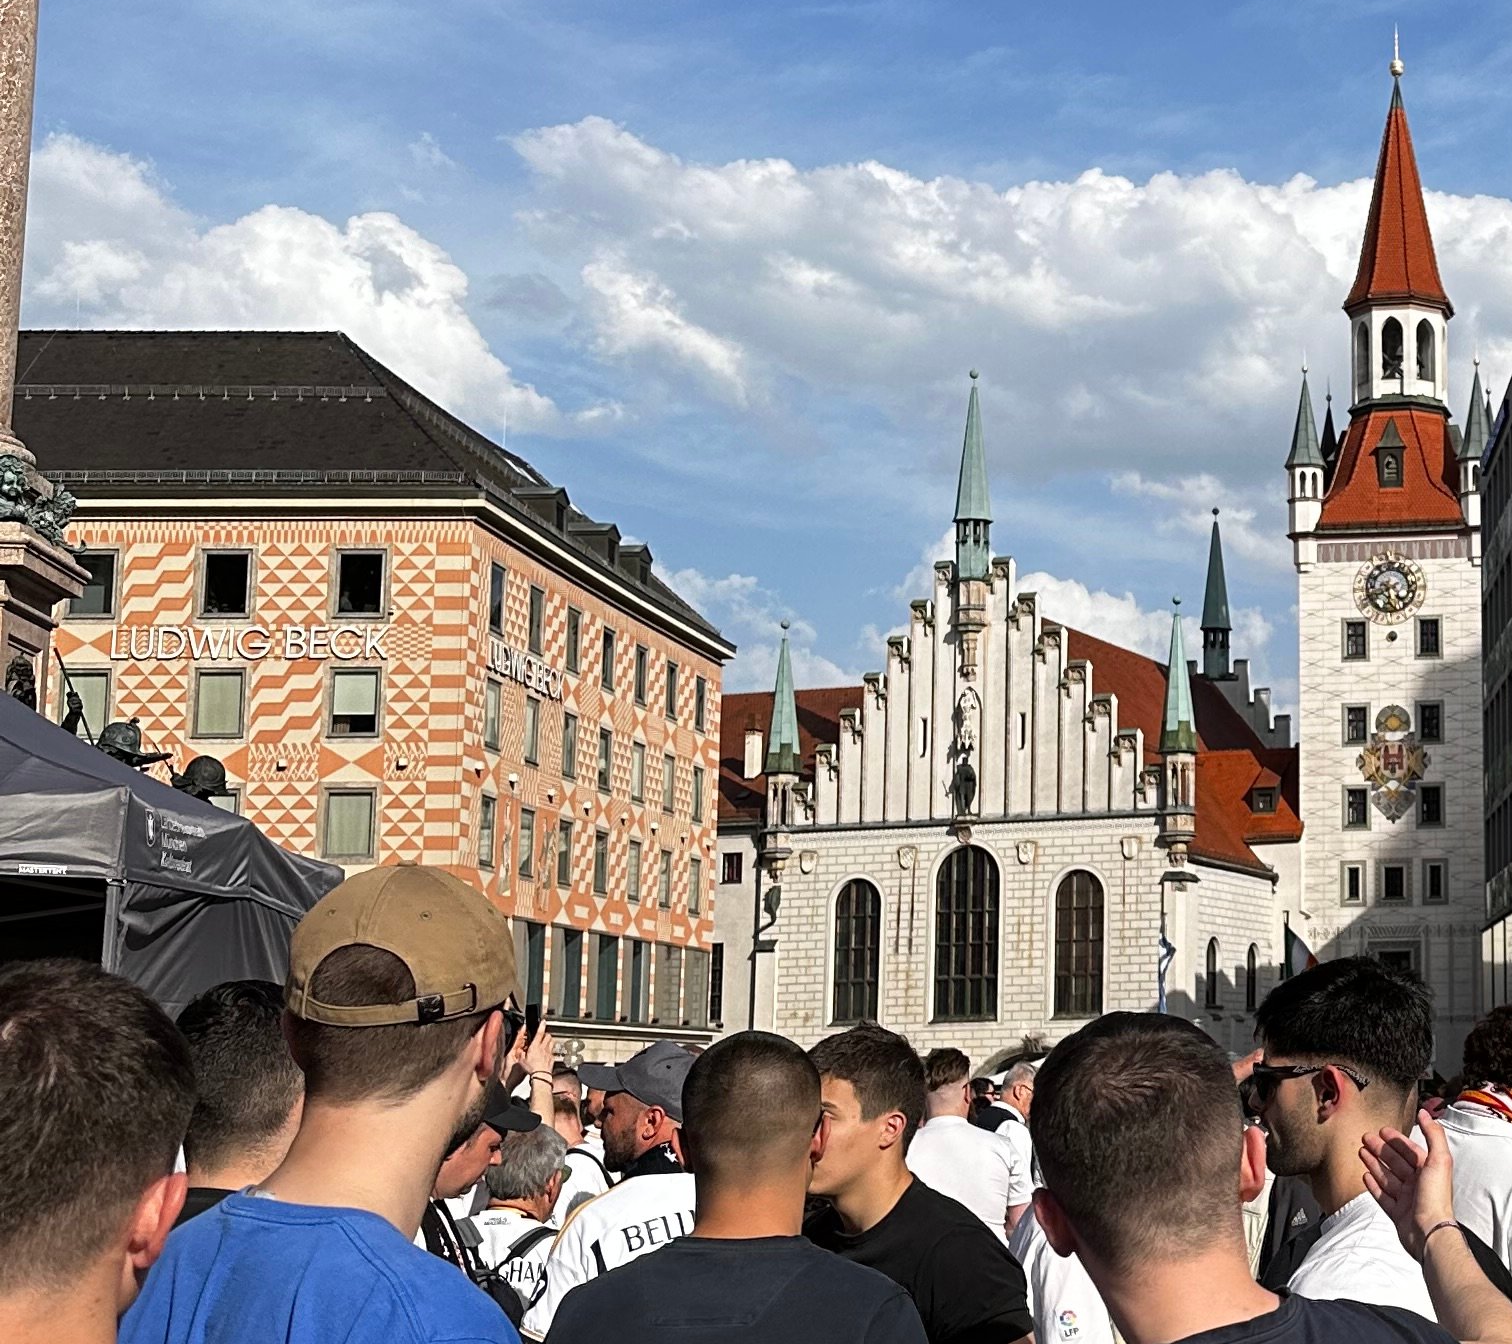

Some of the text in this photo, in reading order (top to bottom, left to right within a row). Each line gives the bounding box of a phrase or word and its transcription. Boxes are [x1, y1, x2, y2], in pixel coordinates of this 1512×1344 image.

[109, 625, 390, 661] LUDWIG BECK
[1063, 1327, 1080, 1338] LFP
